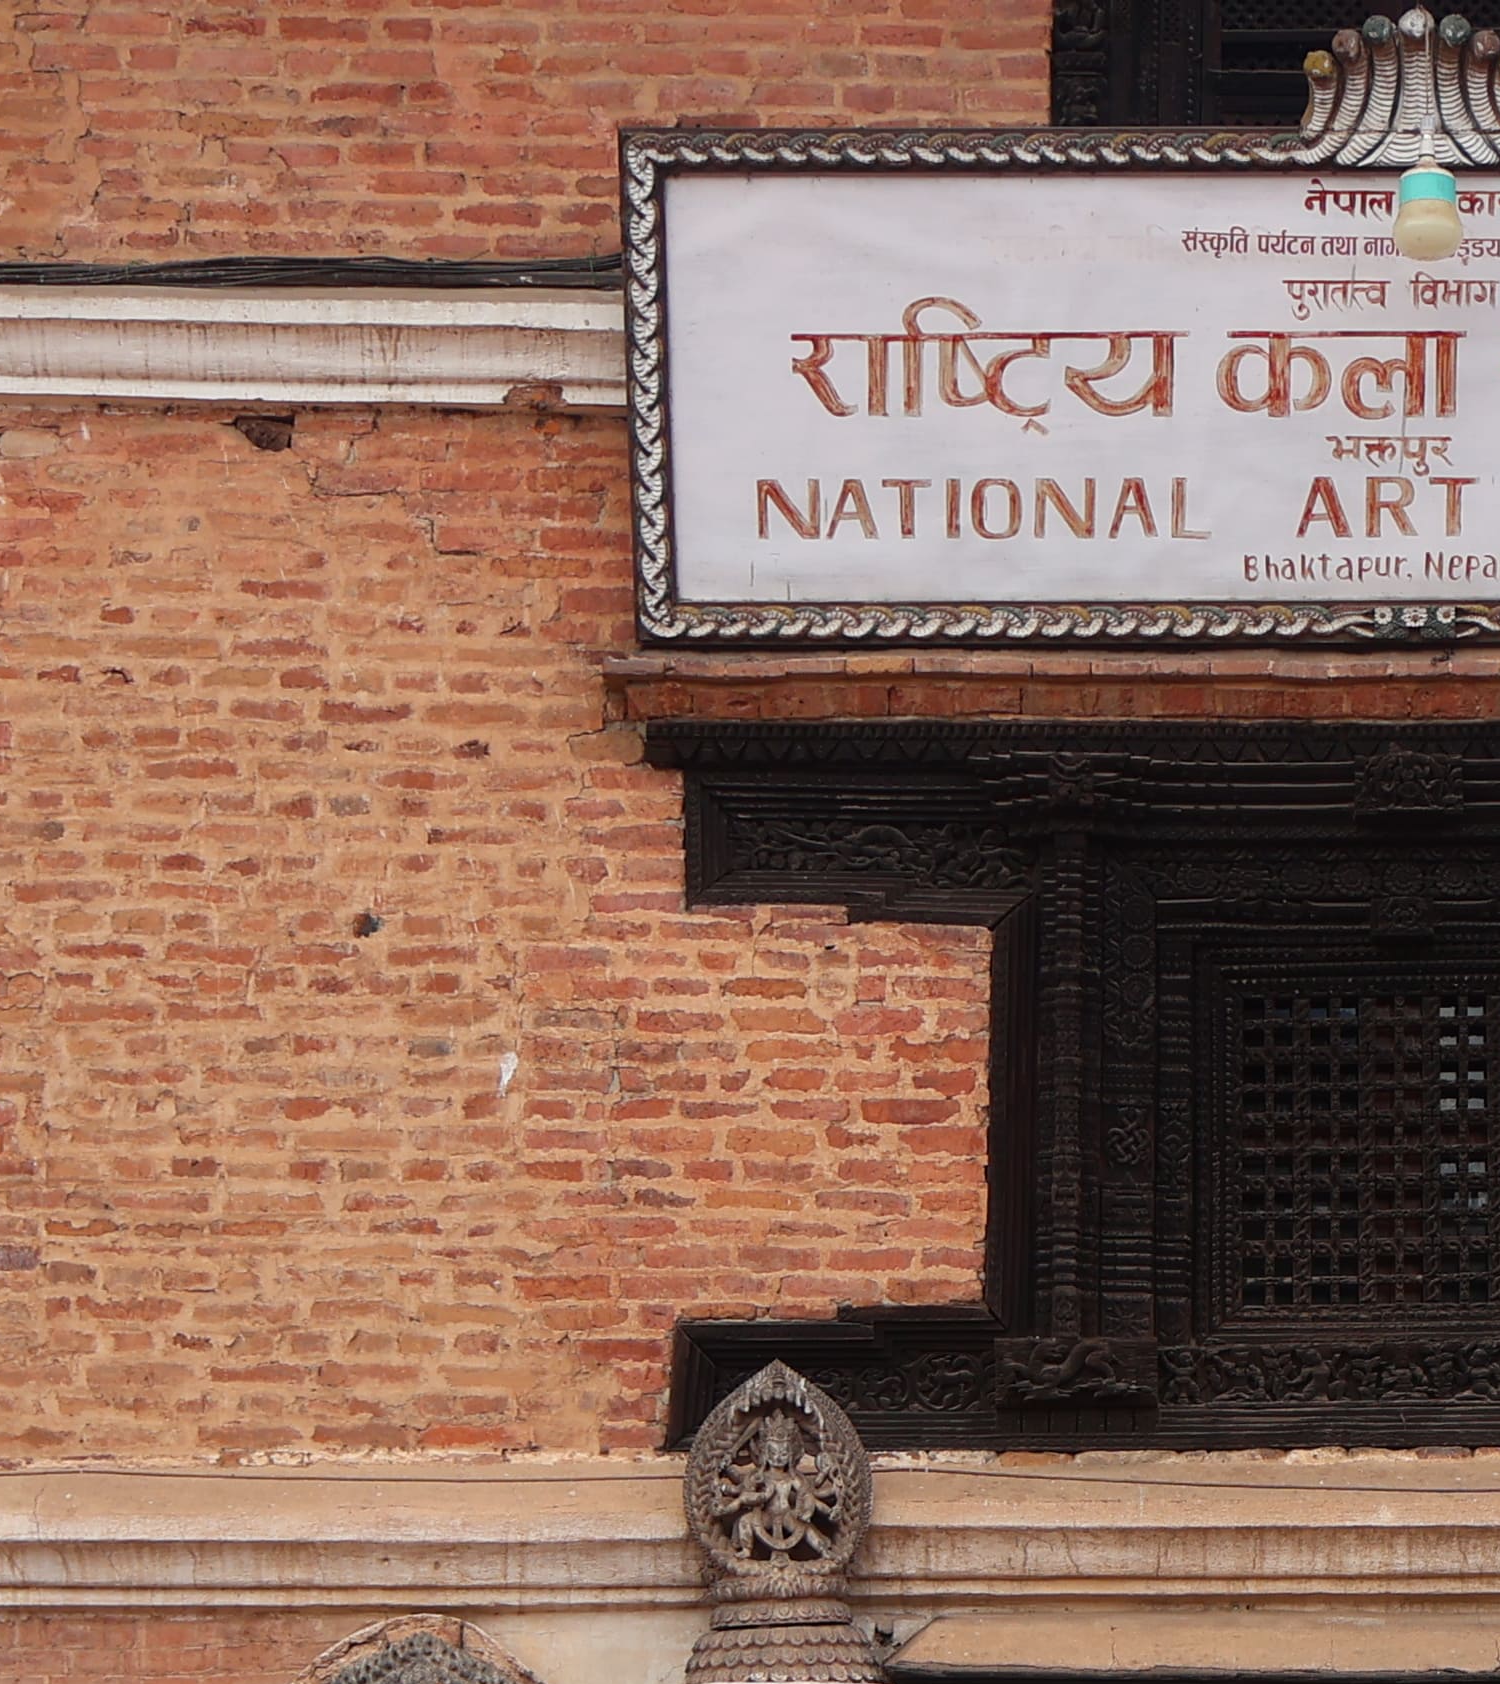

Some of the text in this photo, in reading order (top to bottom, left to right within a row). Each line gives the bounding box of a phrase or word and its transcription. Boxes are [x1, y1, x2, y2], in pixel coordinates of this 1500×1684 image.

[1304, 178, 1396, 218] नेपाल
[1181, 227, 1250, 259] संस्कृति
[1321, 236, 1358, 257] तथा
[1409, 271, 1500, 310] विभाग
[1216, 330, 1468, 419] कला
[1325, 436, 1453, 476] भक्तपुर
[757, 478, 1211, 540] NATIONAL
[1296, 477, 1478, 538] ART
[1244, 554, 1413, 583] Bhaktapur,
